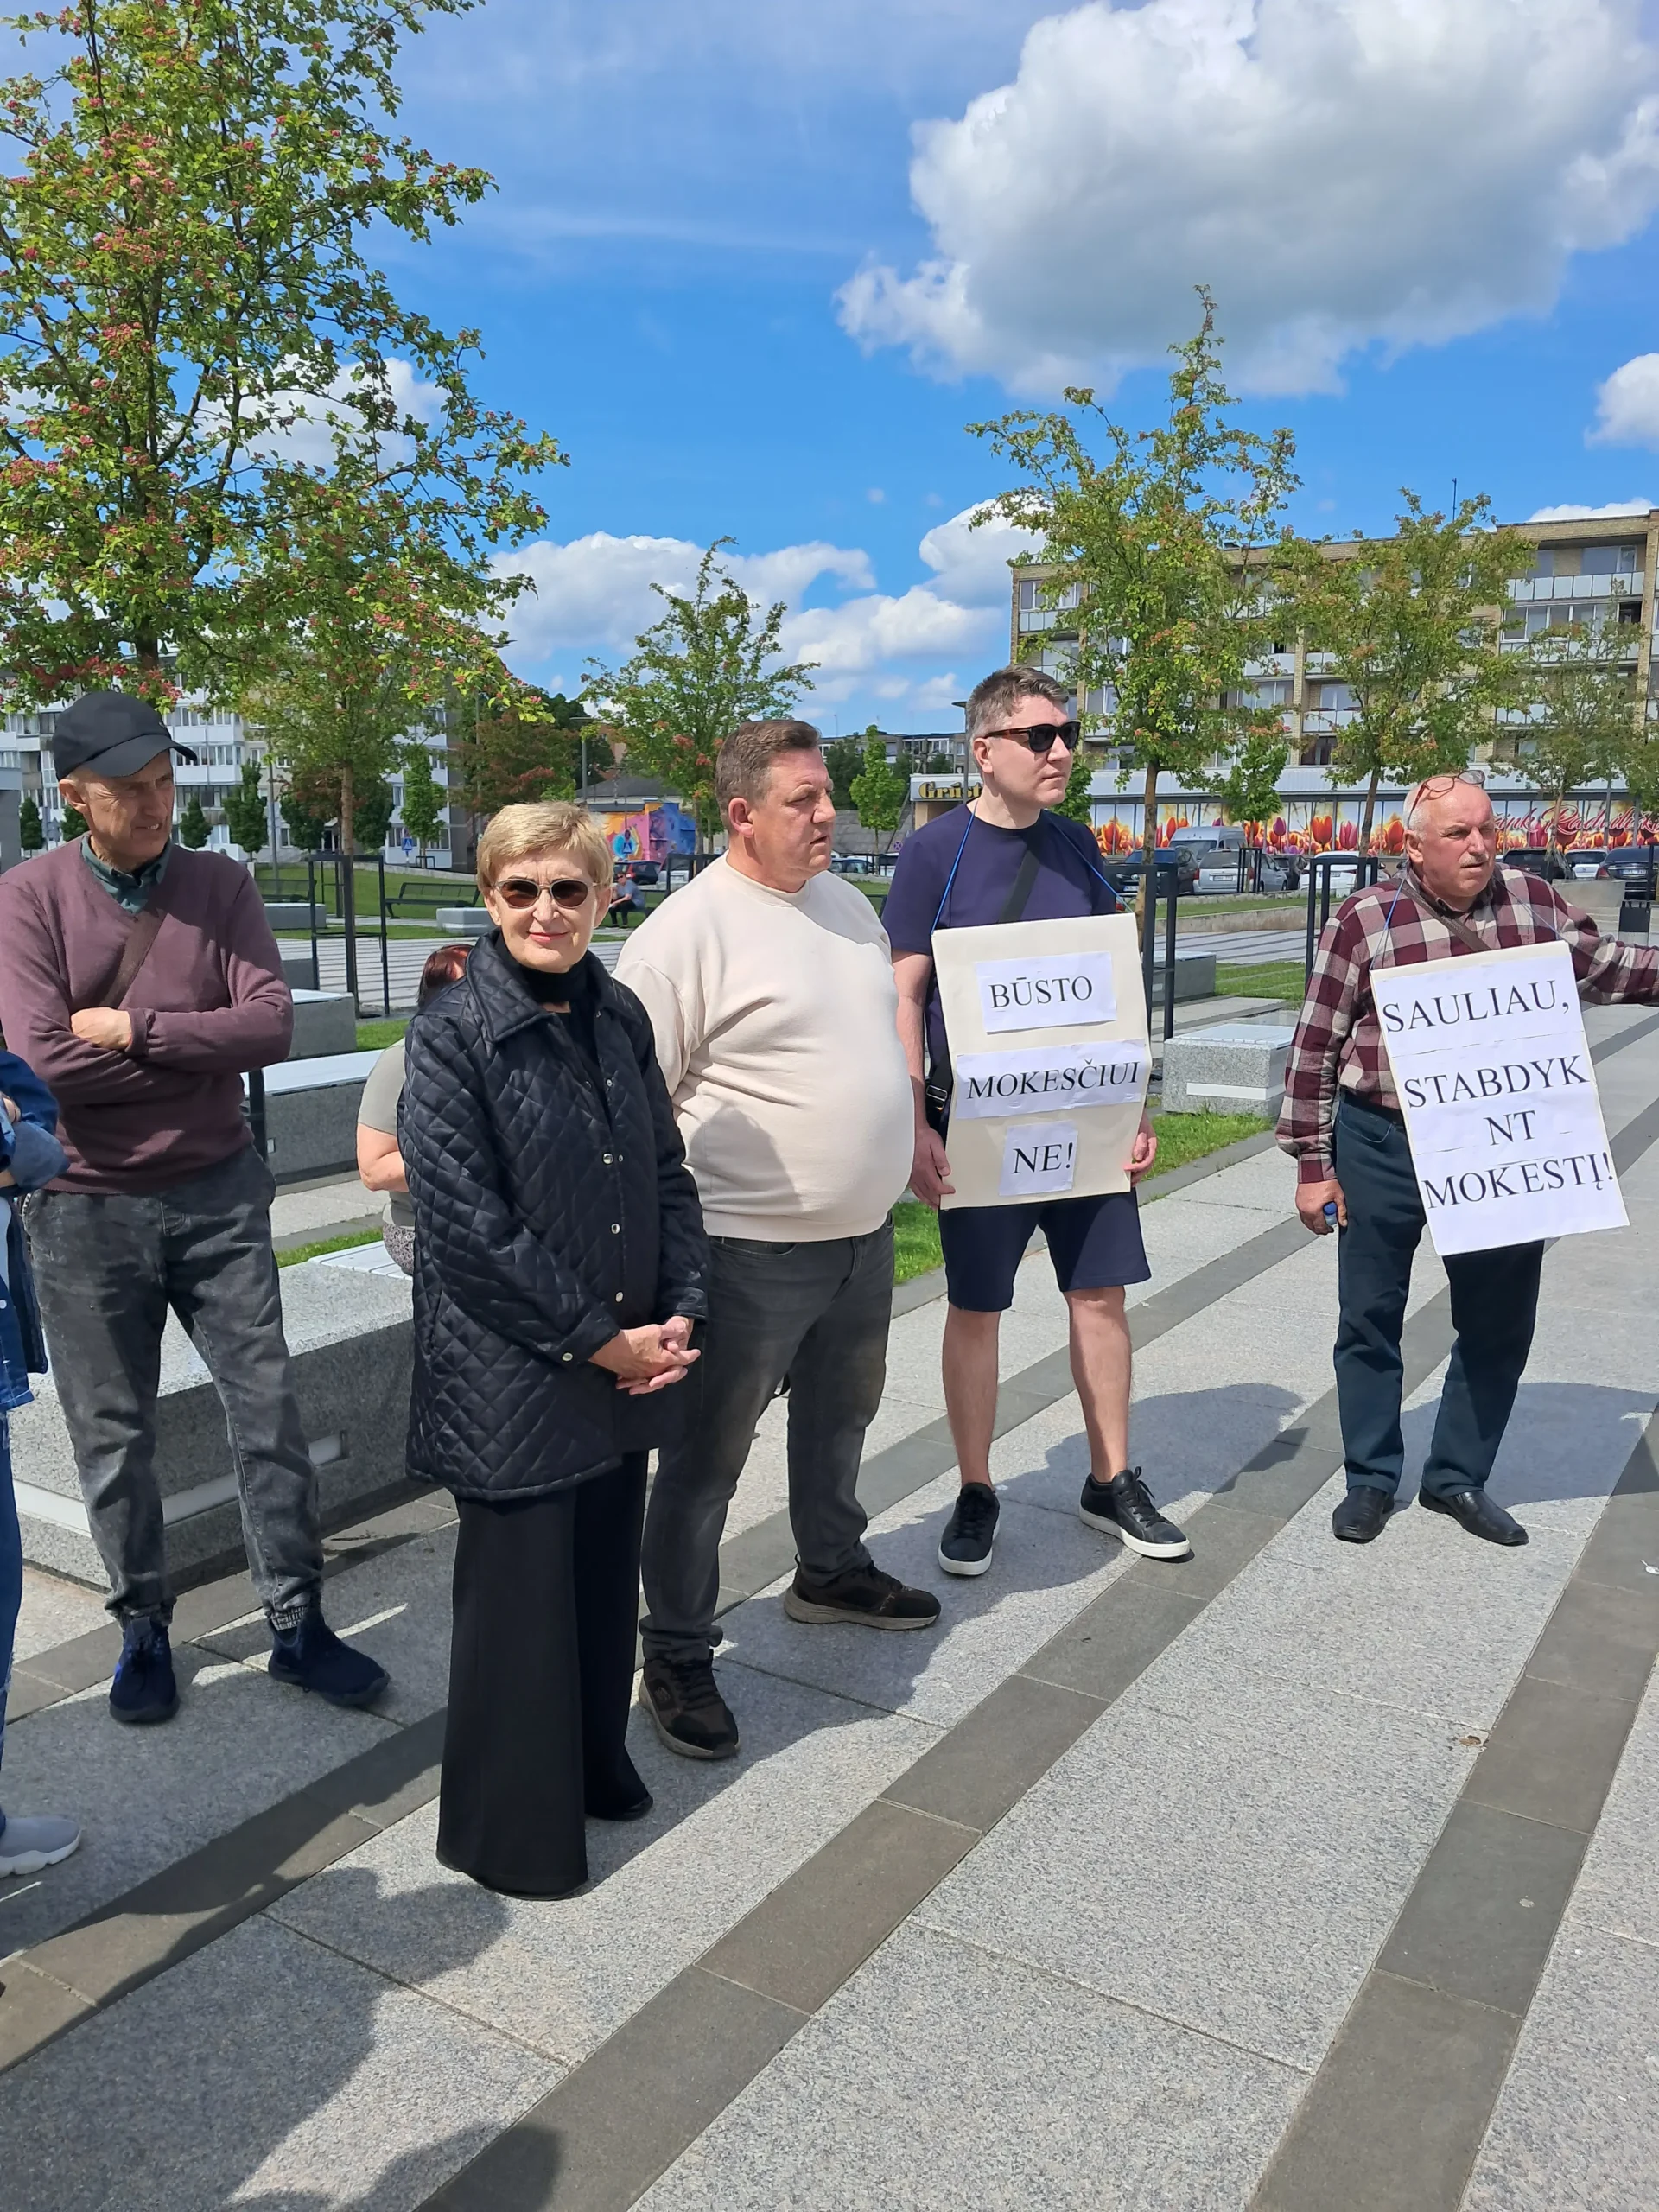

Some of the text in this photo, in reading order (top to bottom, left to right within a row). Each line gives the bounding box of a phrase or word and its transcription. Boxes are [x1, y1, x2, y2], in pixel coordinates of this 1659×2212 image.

[918, 781, 982, 799] Grūst
[988, 976, 1093, 1008] BŪSTO
[1382, 980, 1569, 1033] SAULIAU,
[966, 1059, 1141, 1100] MOKESČIUI
[1404, 1055, 1590, 1108] STABDYK
[1483, 1110, 1536, 1146] NT
[1011, 1142, 1074, 1174] NE!
[1421, 1152, 1614, 1209] MOKESTĮ!
